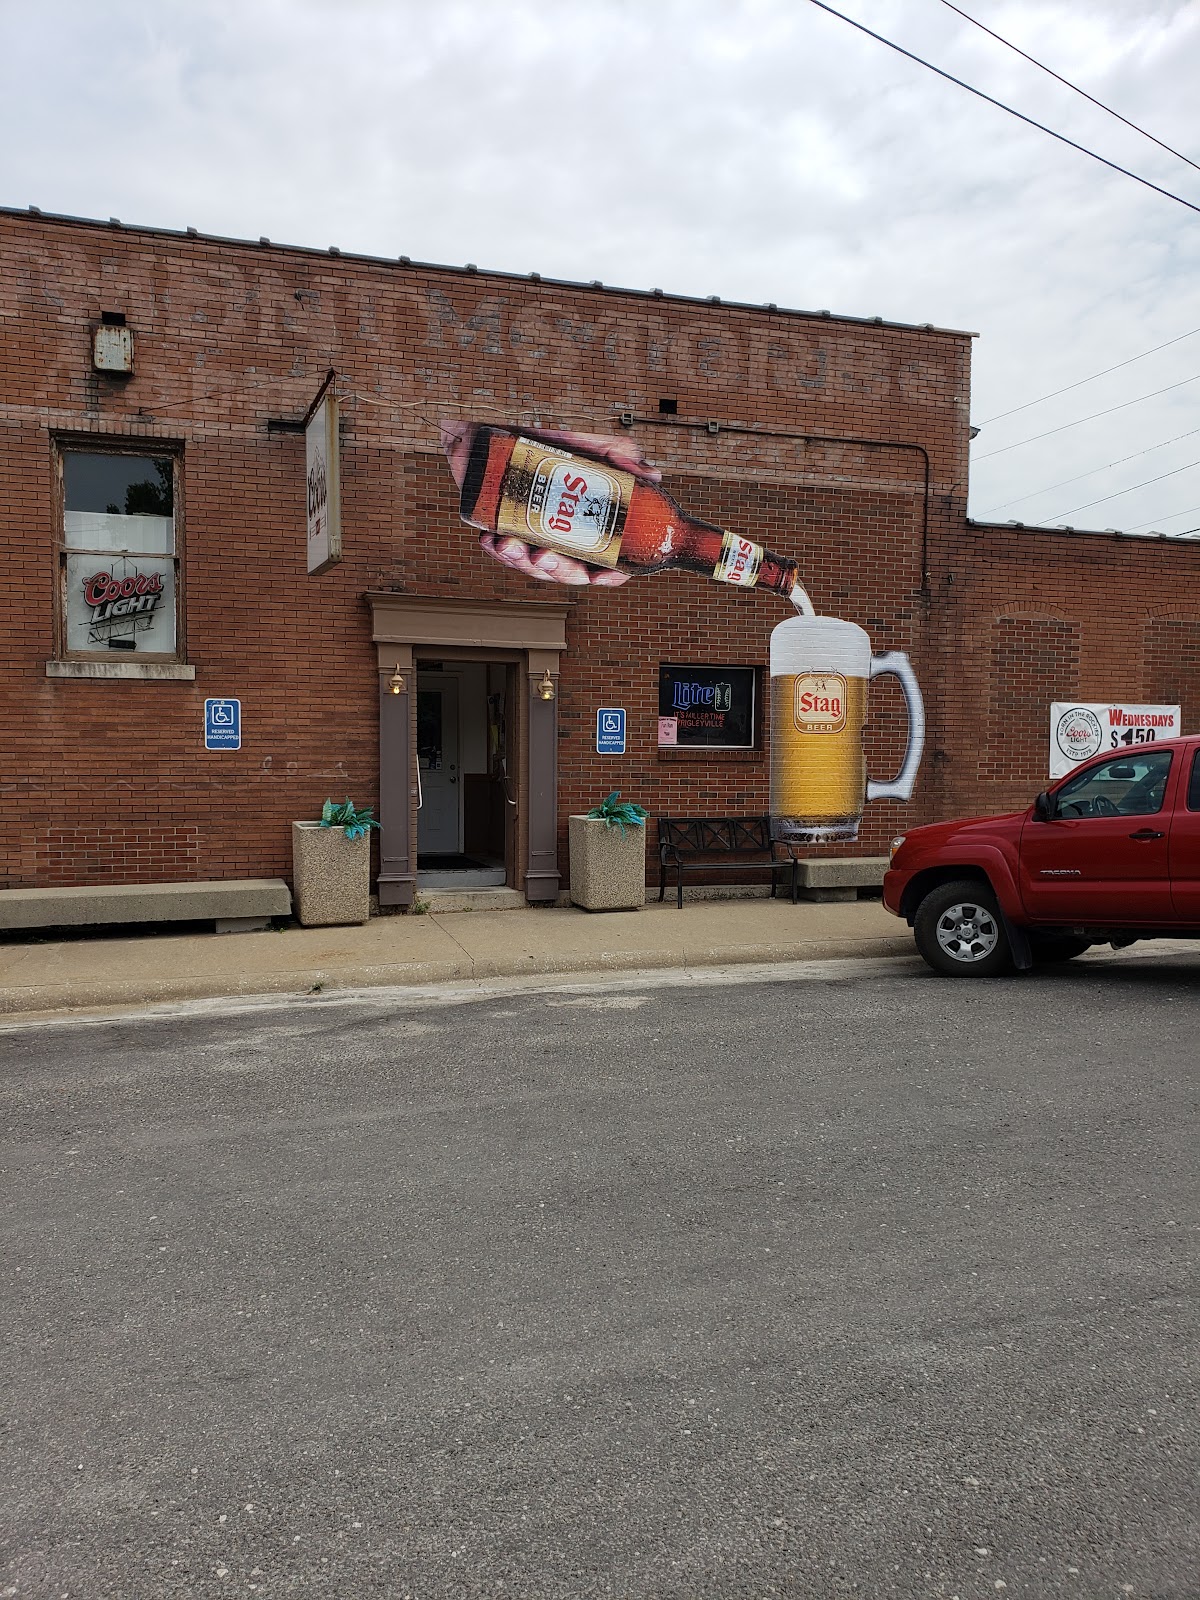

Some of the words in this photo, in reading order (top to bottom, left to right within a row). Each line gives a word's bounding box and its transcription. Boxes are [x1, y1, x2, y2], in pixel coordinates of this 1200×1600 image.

[530, 474, 547, 514] BEER
[548, 472, 588, 533] Stag
[727, 539, 753, 581] Stag
[82, 571, 163, 607] Coors
[91, 594, 160, 624] LIGHT
[672, 681, 715, 710] Lite
[800, 692, 841, 718] Stag
[673, 710, 685, 719] IT'S
[686, 711, 709, 721] MILLER
[710, 713, 726, 721] TIME
[1060, 718, 1069, 736] BORN
[1085, 713, 1100, 737] ROCKIES
[1108, 709, 1174, 727] WEDNESDAYS
[1066, 726, 1091, 737] Coors
